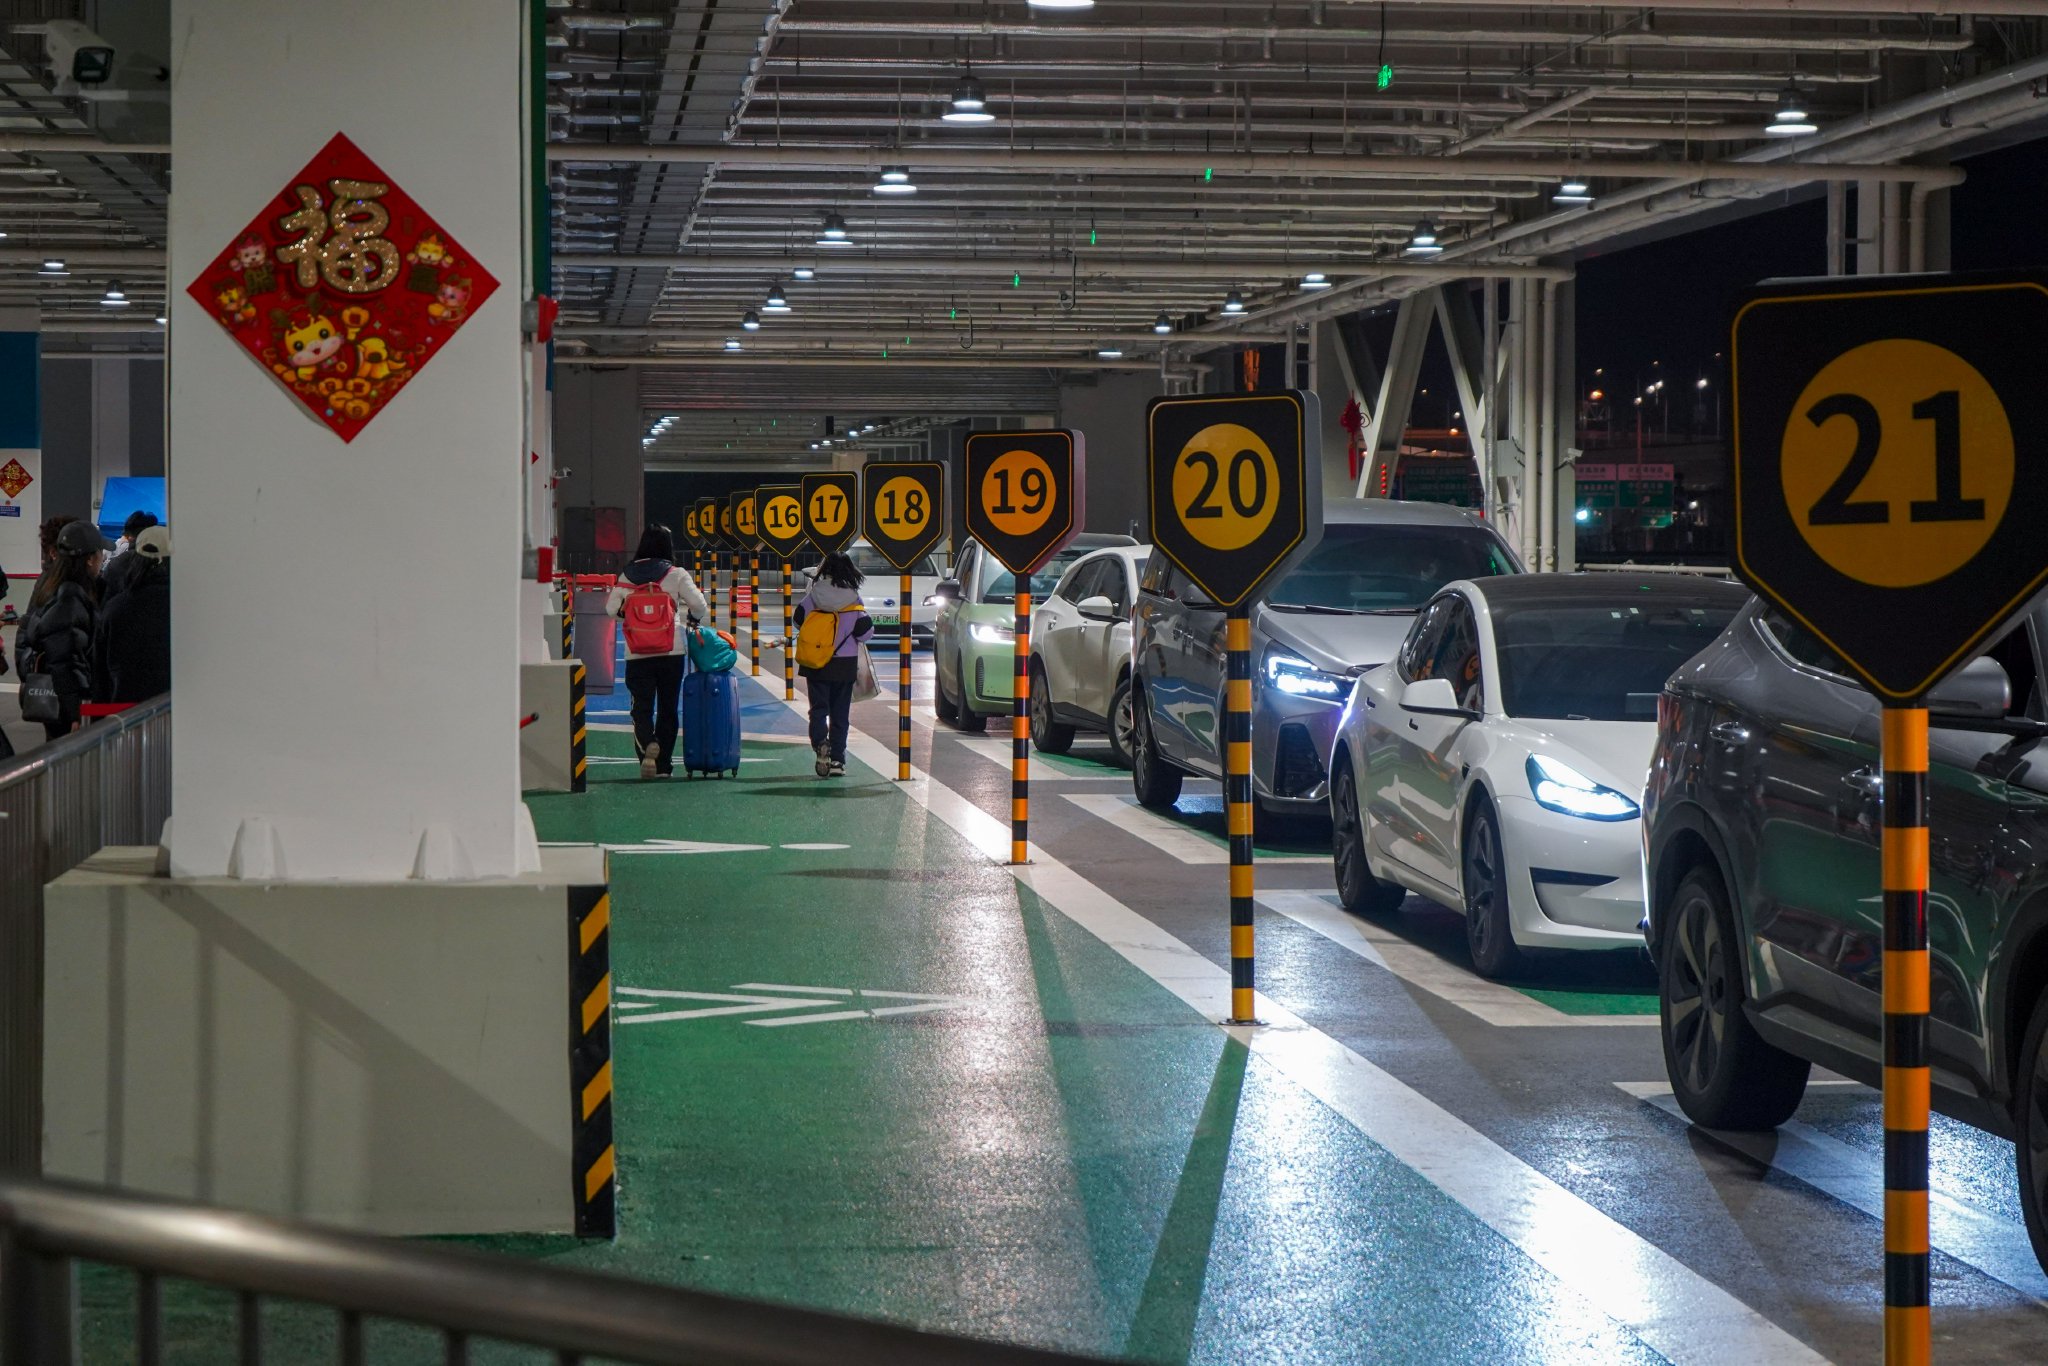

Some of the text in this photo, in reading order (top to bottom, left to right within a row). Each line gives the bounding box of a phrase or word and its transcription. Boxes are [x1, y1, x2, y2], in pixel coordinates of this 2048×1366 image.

[275, 178, 400, 293] 福
[1806, 390, 1985, 526] 21
[882, 489, 924, 525] 18
[991, 467, 1047, 515] 19
[1183, 448, 1267, 519] 20
[769, 504, 800, 528] 16
[814, 495, 844, 523] 17
